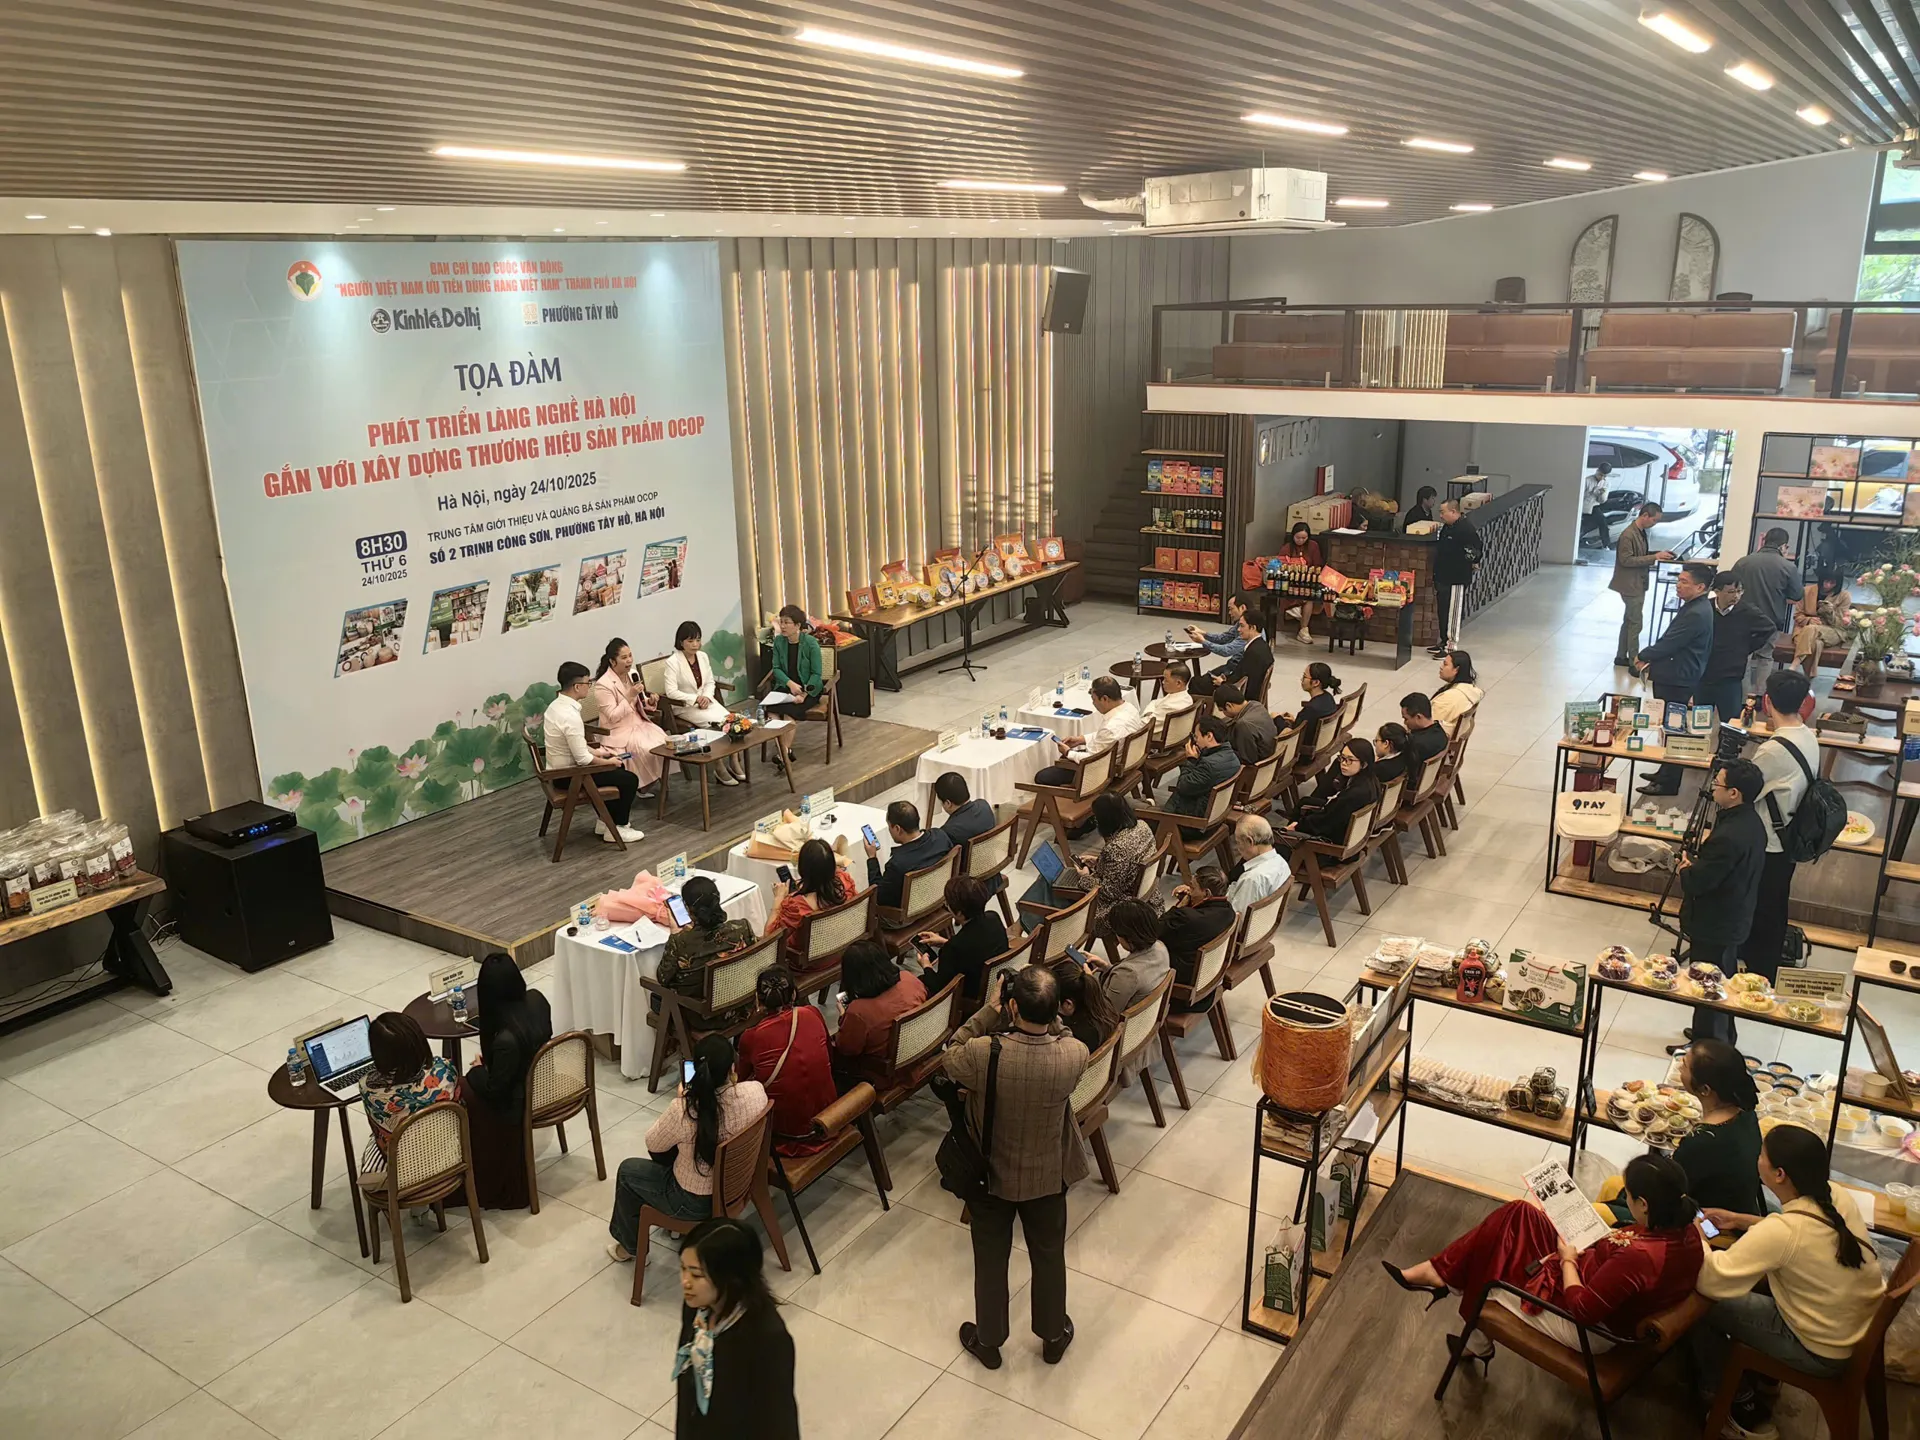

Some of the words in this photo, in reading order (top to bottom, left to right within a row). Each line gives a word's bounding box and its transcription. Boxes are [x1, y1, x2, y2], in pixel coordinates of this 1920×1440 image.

[430, 261, 450, 275] BAN
[401, 280, 424, 295] NAM
[542, 305, 582, 323] PHƯỜNG
[585, 303, 603, 321] TÂY
[606, 300, 618, 319] HỒ
[454, 362, 503, 396] TỌA
[509, 352, 562, 386] ĐÀM
[367, 417, 420, 447] PHÁT
[426, 406, 481, 440] TRIỂN
[486, 406, 531, 432] LÀNG
[536, 395, 579, 426] NGHỀ
[583, 396, 605, 420] HÀ
[610, 392, 636, 419] NỘI
[263, 463, 312, 498] GẮN
[317, 459, 357, 489] VỚI
[362, 454, 401, 484] XÂY
[408, 448, 462, 478] DỰNG
[467, 437, 540, 467] THƯƠNG
[544, 430, 582, 457] HIỆU
[586, 424, 617, 450] SẢN
[621, 416, 664, 445] PHẨM
[668, 416, 705, 438] OCOP
[437, 494, 457, 511] Hà
[462, 489, 490, 508] Nội,
[494, 484, 527, 503] ngày
[530, 471, 597, 495] 24/10/2025
[428, 528, 462, 542] TRUNG
[464, 523, 484, 536] TÂM
[487, 519, 507, 531] GIỚI
[508, 514, 534, 528] THIỆU
[536, 510, 548, 521] VÀ
[550, 505, 580, 519] QUẢNG
[582, 501, 594, 513] BÁ
[637, 491, 658, 503] OCOP
[360, 533, 403, 556] 8H30
[429, 546, 445, 564] SỐ
[449, 548, 457, 560] 2
[459, 540, 494, 558] TRỊNH
[497, 533, 527, 550] CÔNG
[529, 528, 553, 544] SƠN,
[555, 520, 595, 539] PHƯỜNG
[598, 516, 615, 530] TÂY
[618, 511, 633, 526] HỒ,
[650, 506, 665, 520] NỘI
[361, 555, 394, 573] THỨ
[399, 555, 407, 566] 6
[361, 569, 408, 586] 24/10/2025
